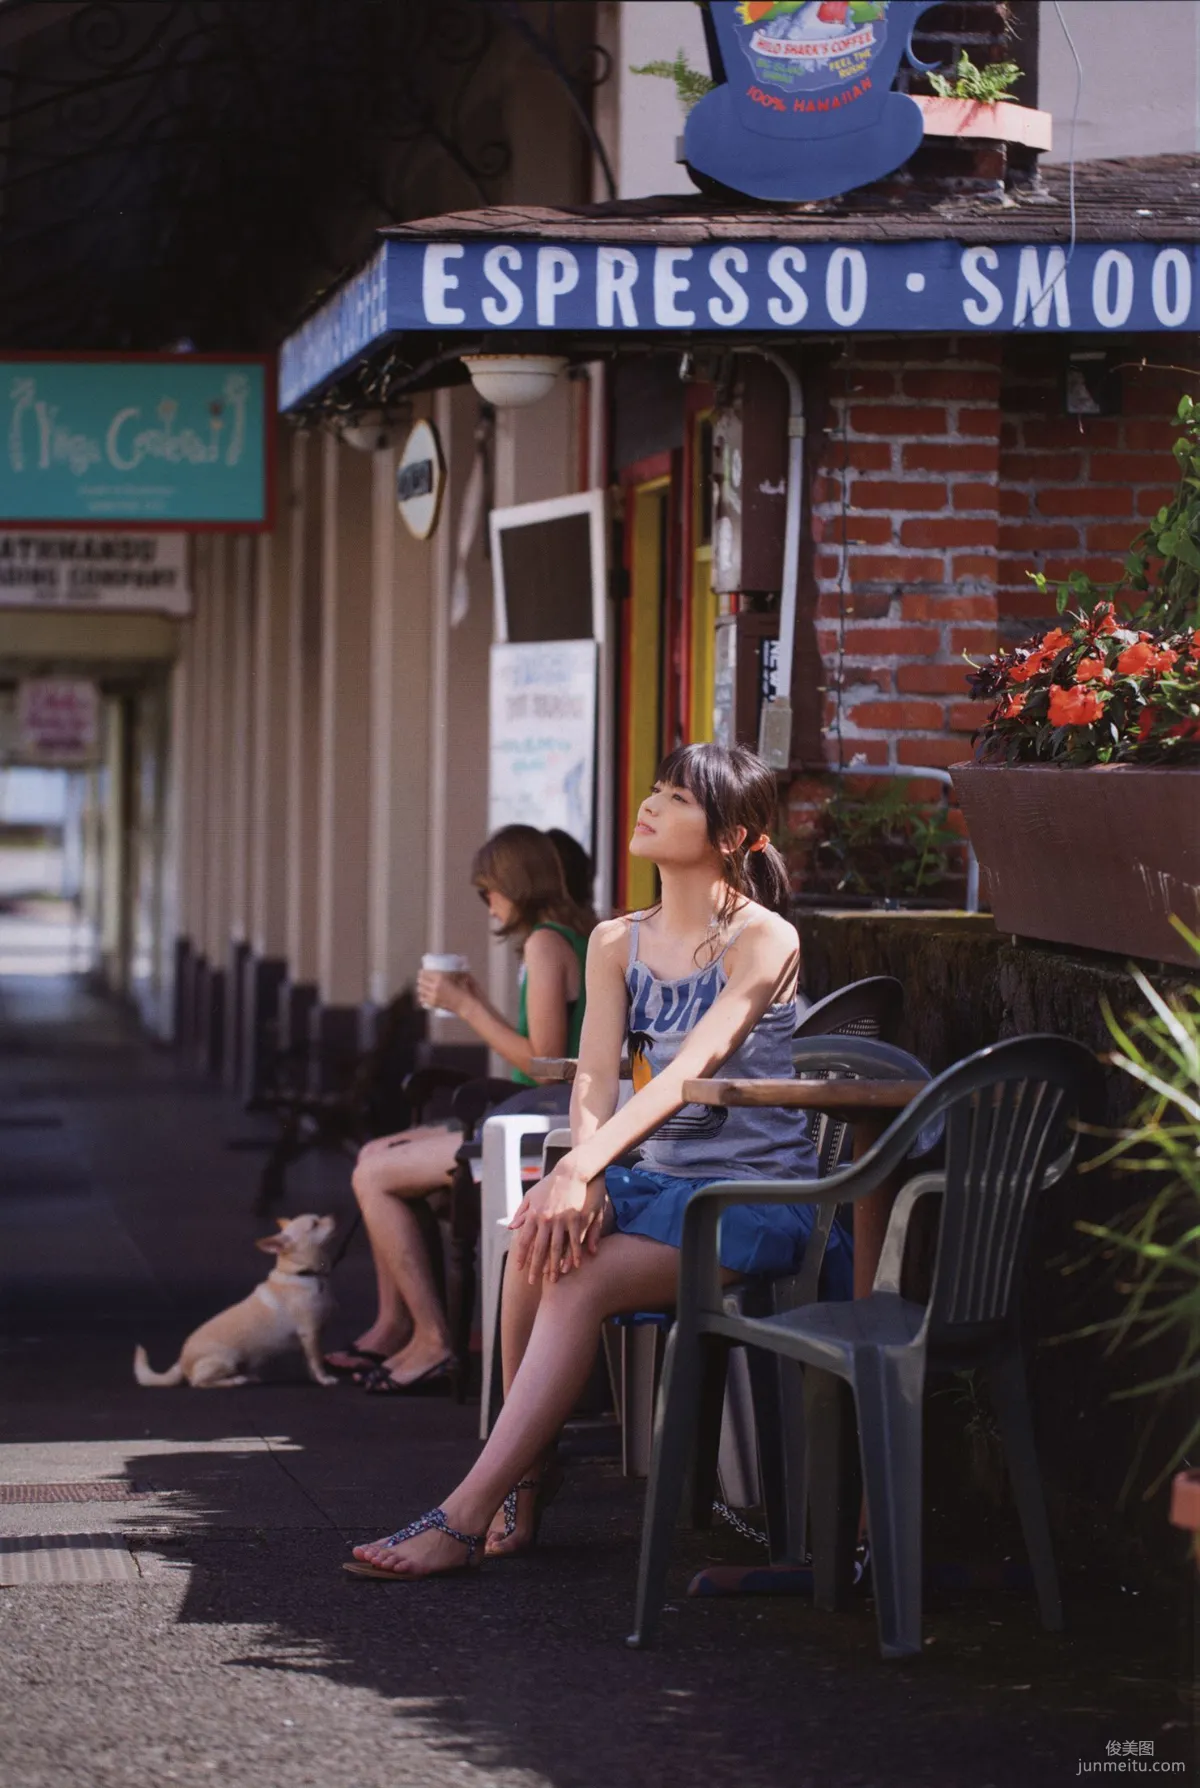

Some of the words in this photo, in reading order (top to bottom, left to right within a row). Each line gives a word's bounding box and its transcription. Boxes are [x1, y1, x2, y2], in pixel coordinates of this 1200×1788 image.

[831, 32, 872, 53] COFFEE
[746, 85, 786, 112] 100%
[422, 243, 868, 328] ESPRESSO
[960, 246, 1192, 328] SMOO
